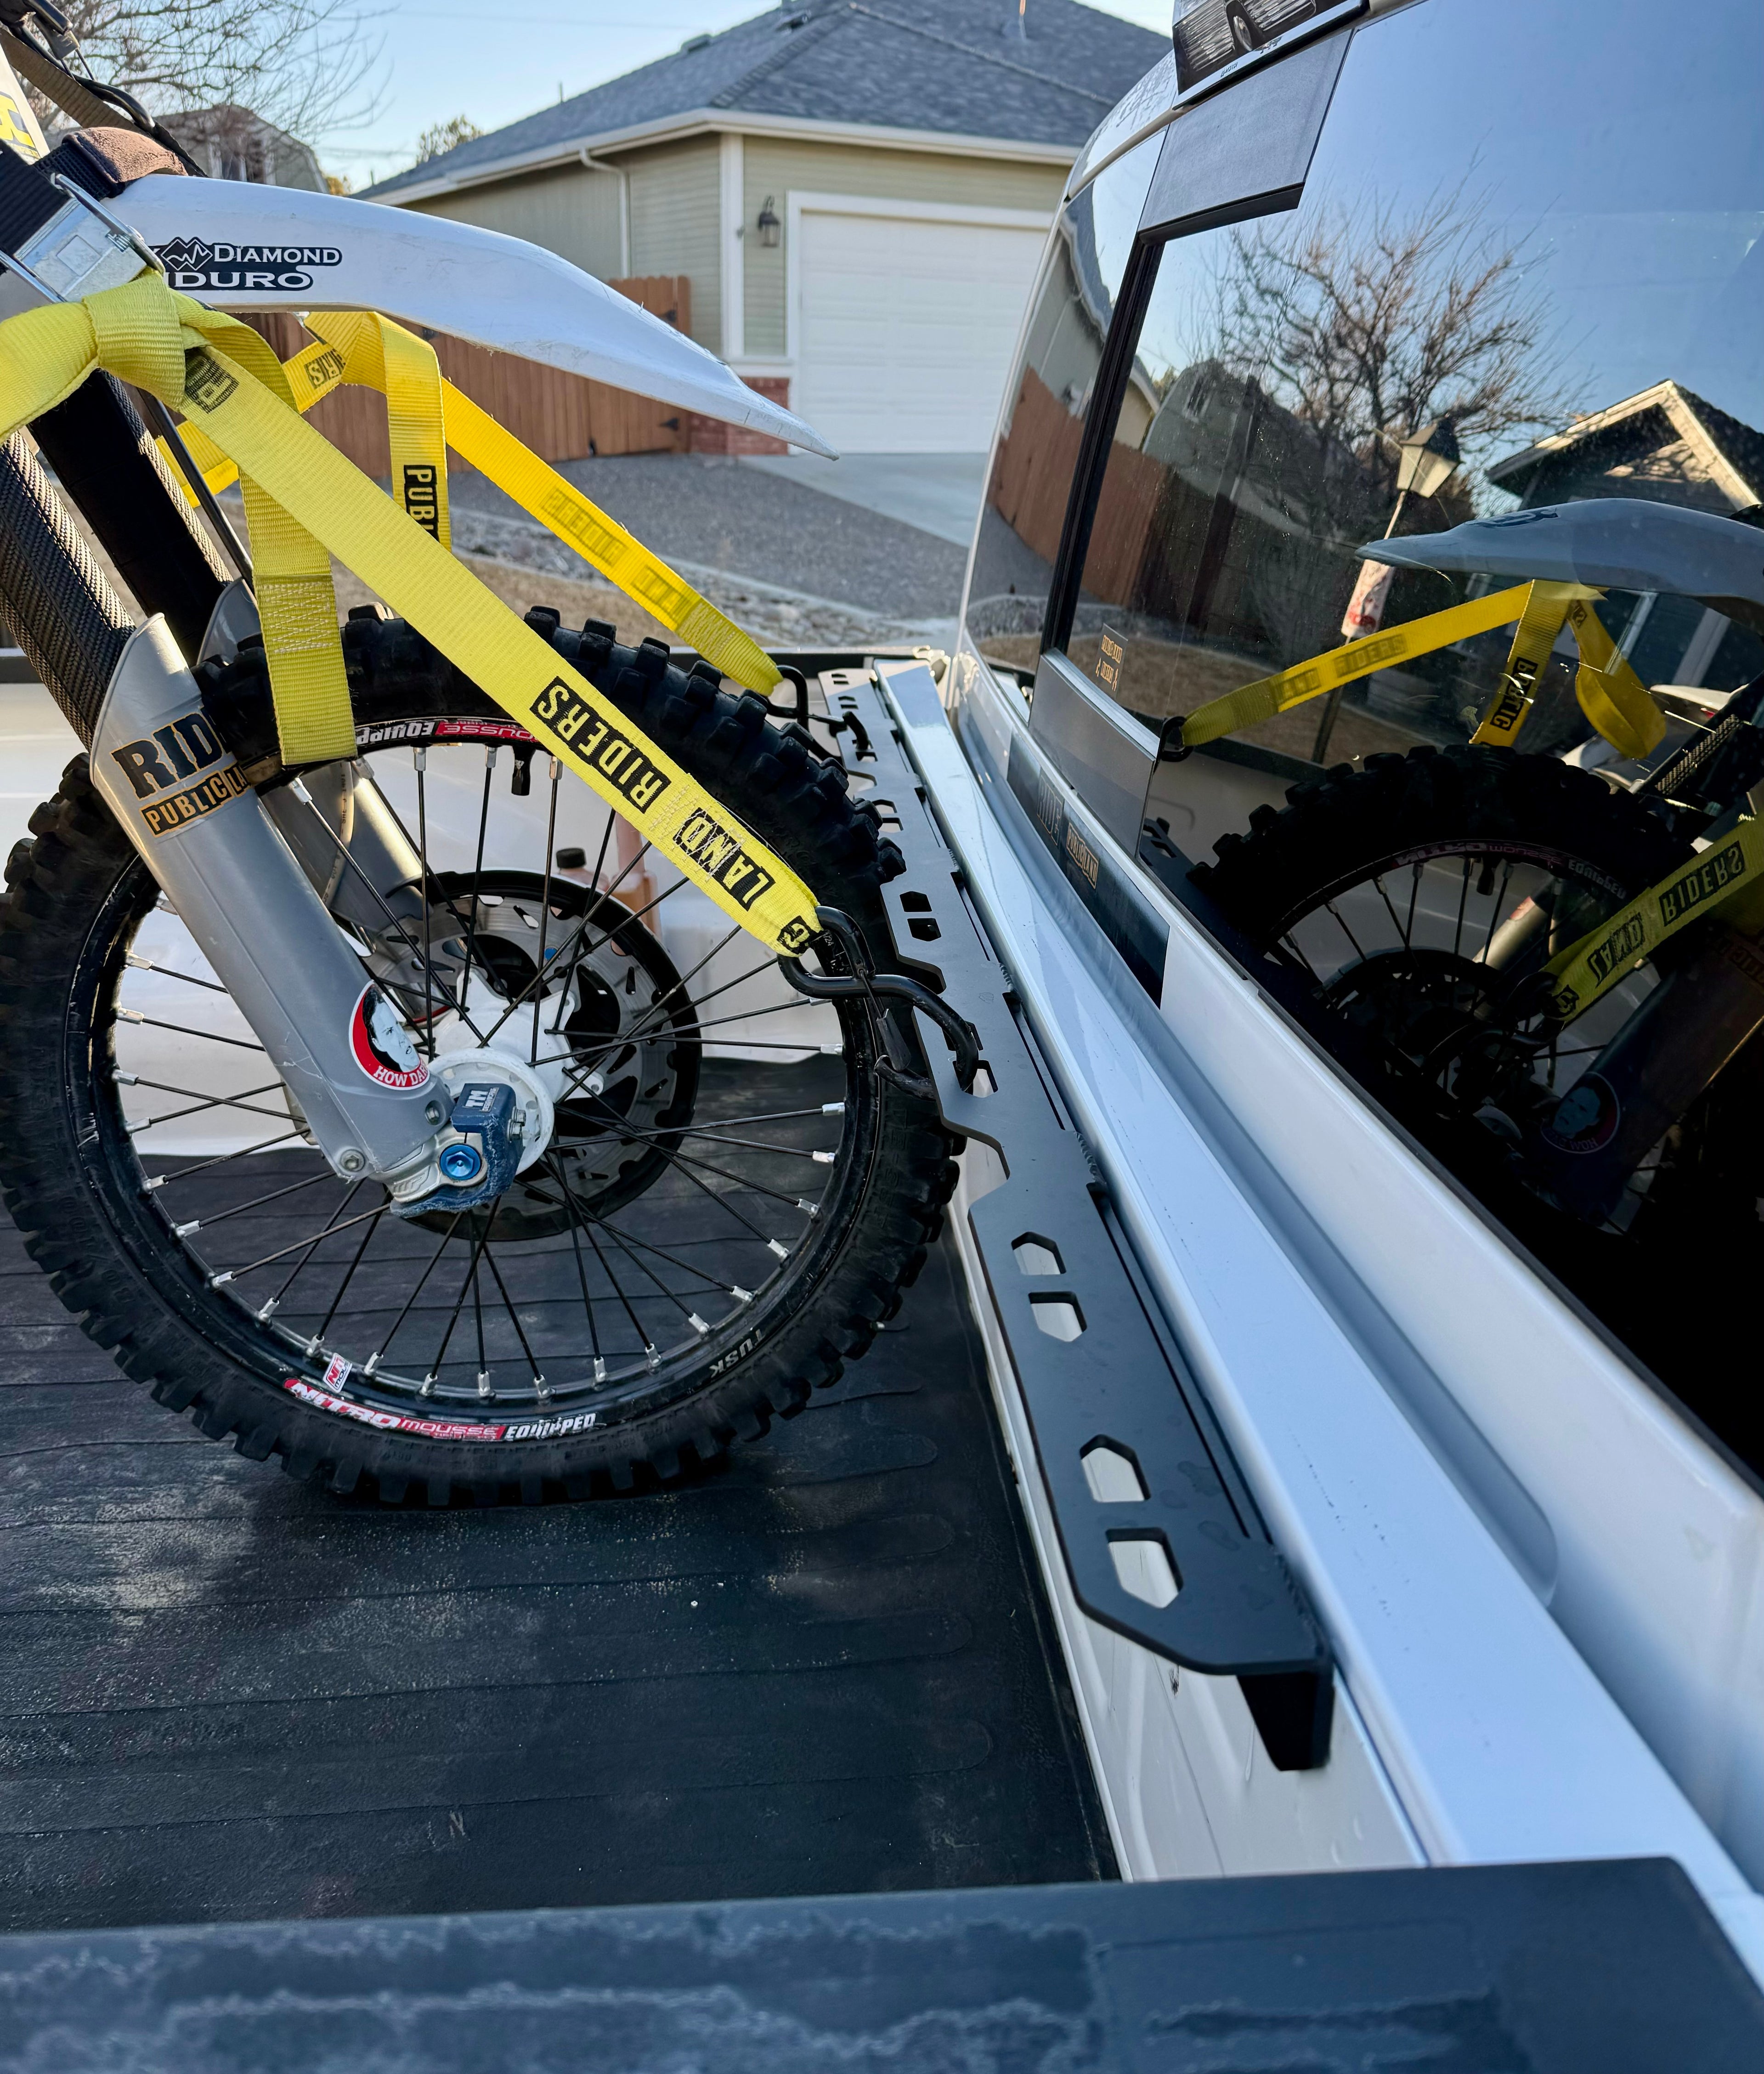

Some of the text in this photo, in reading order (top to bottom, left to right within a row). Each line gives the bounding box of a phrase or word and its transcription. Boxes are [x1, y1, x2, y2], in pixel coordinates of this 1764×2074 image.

[214, 245, 339, 263] DIAMOND
[164, 272, 311, 288] DURO
[407, 469, 435, 530] PUB
[109, 712, 224, 801] RID
[356, 722, 535, 745] OUSSE EQUIPP
[146, 767, 248, 832] PUBLIC LA
[538, 685, 771, 903] LAND RIDERS
[373, 1065, 408, 1087] HOW
[465, 1090, 489, 1107] TM
[709, 1329, 765, 1378] TUSK
[291, 1380, 402, 1428] NITRO
[401, 1419, 498, 1437] MOUSSE
